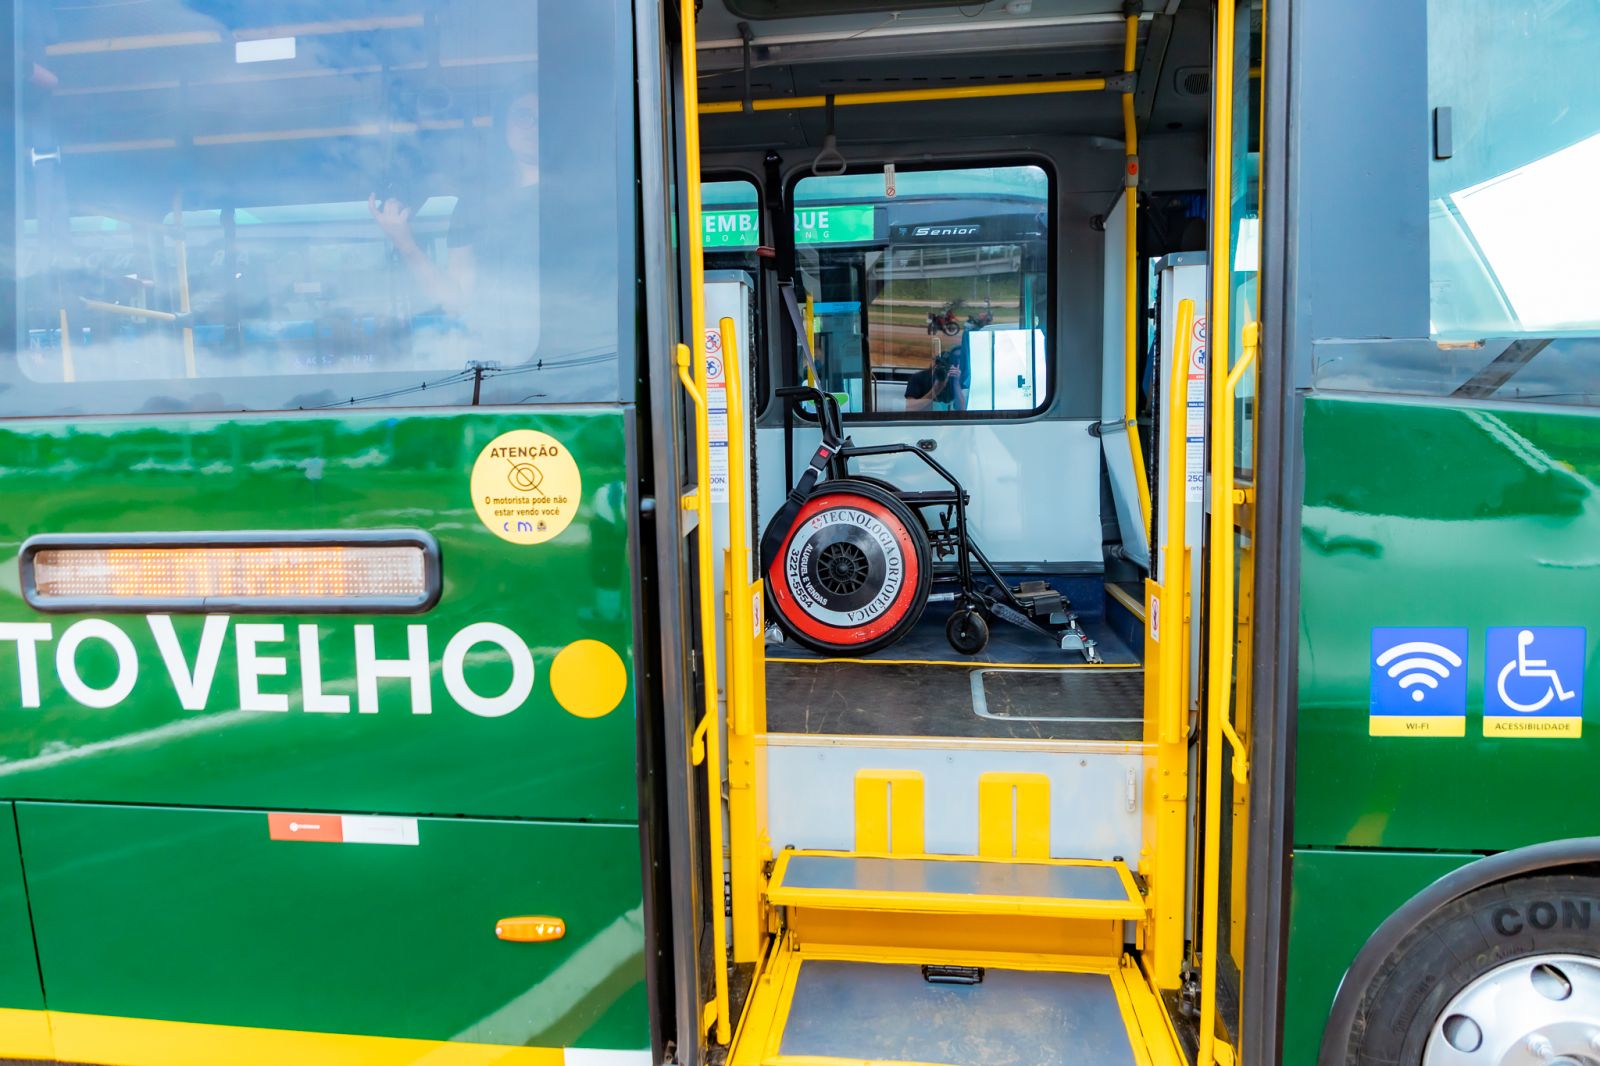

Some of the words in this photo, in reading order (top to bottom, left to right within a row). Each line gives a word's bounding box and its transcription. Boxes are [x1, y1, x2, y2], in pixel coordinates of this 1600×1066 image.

[915, 227, 977, 236] Senior
[490, 444, 558, 460] ATENÇÃO
[485, 496, 490, 505] O
[493, 496, 530, 505] motorista
[532, 496, 551, 506] pode
[554, 495, 568, 504] não
[516, 508, 539, 516] vendo
[542, 507, 560, 516] você
[820, 510, 896, 555] TECNOLOGIA
[789, 548, 814, 609] 3221-5554
[800, 543, 814, 577] ALUGUEL
[807, 581, 828, 606] VENDAS
[1406, 722, 1429, 730] WI-FI
[1494, 723, 1570, 731] ACESSIBILIDADE
